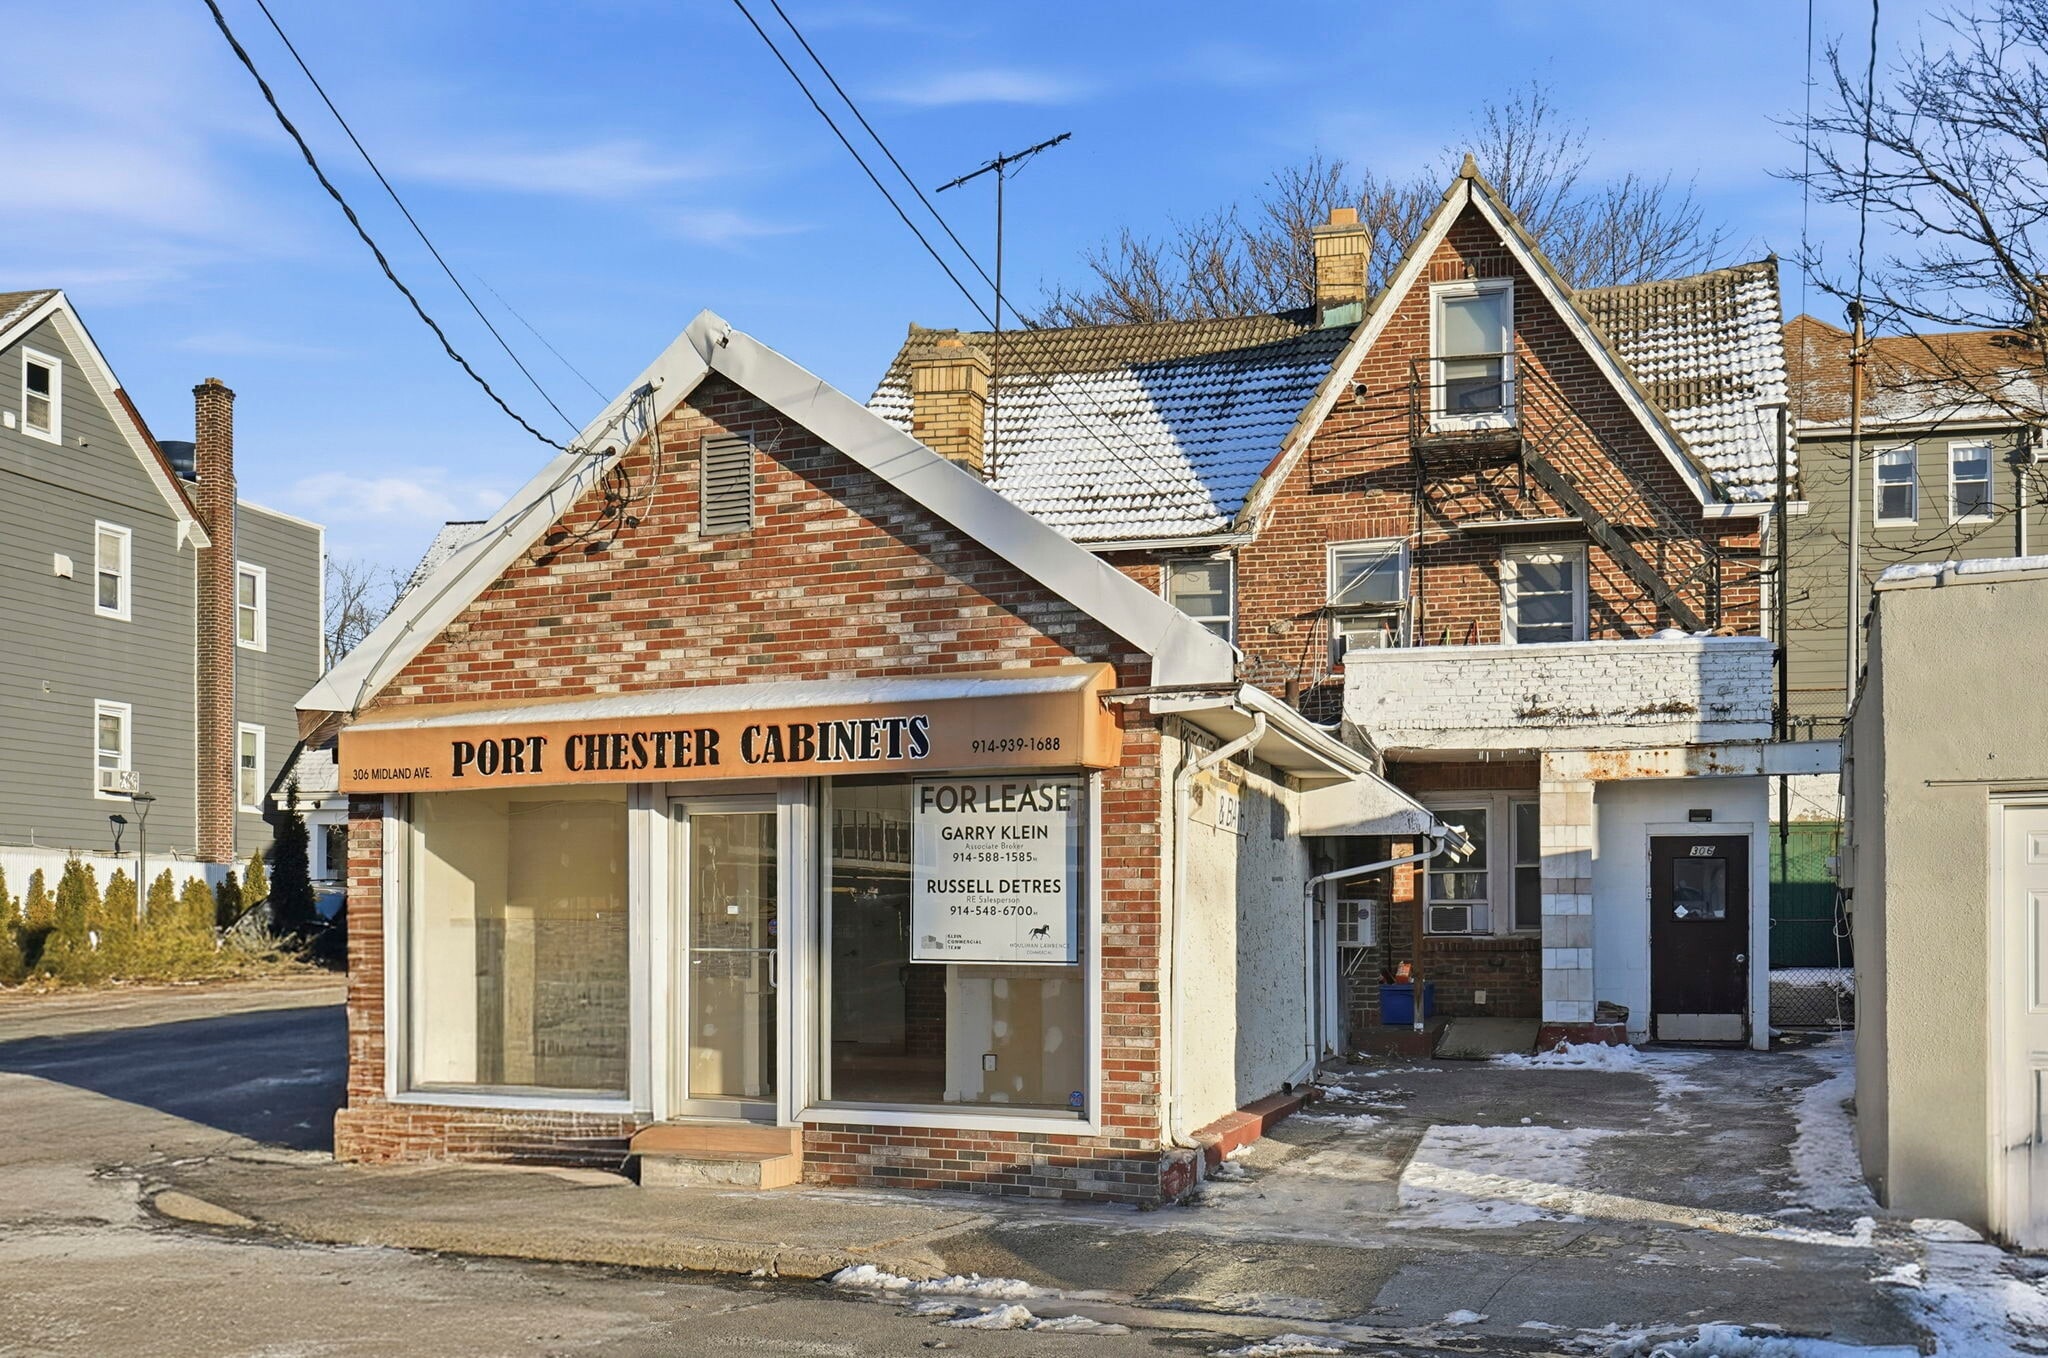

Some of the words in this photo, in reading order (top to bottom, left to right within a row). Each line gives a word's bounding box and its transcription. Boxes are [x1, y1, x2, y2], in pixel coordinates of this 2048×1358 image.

[451, 736, 547, 778] PORT
[565, 728, 721, 772] CHESTER
[740, 714, 932, 765] CABINETS
[972, 737, 1061, 753] 914-939-1688
[353, 769, 369, 780] 306
[371, 768, 411, 780] MIDLAND
[413, 767, 433, 779] AVE.
[920, 785, 977, 814] FOR
[985, 784, 1071, 813] LEASE
[941, 826, 996, 840] GARRY
[1001, 825, 1048, 840] KLEIN
[965, 842, 998, 850] Associate
[1000, 841, 1024, 850] Broker
[1691, 846, 1713, 856] 306
[952, 852, 1032, 862] 914-588-1585
[927, 880, 994, 893] RUSSELL
[999, 879, 1061, 893] DETRES
[978, 896, 1020, 904] Salesperson
[950, 906, 1033, 916] 914-548-6700
